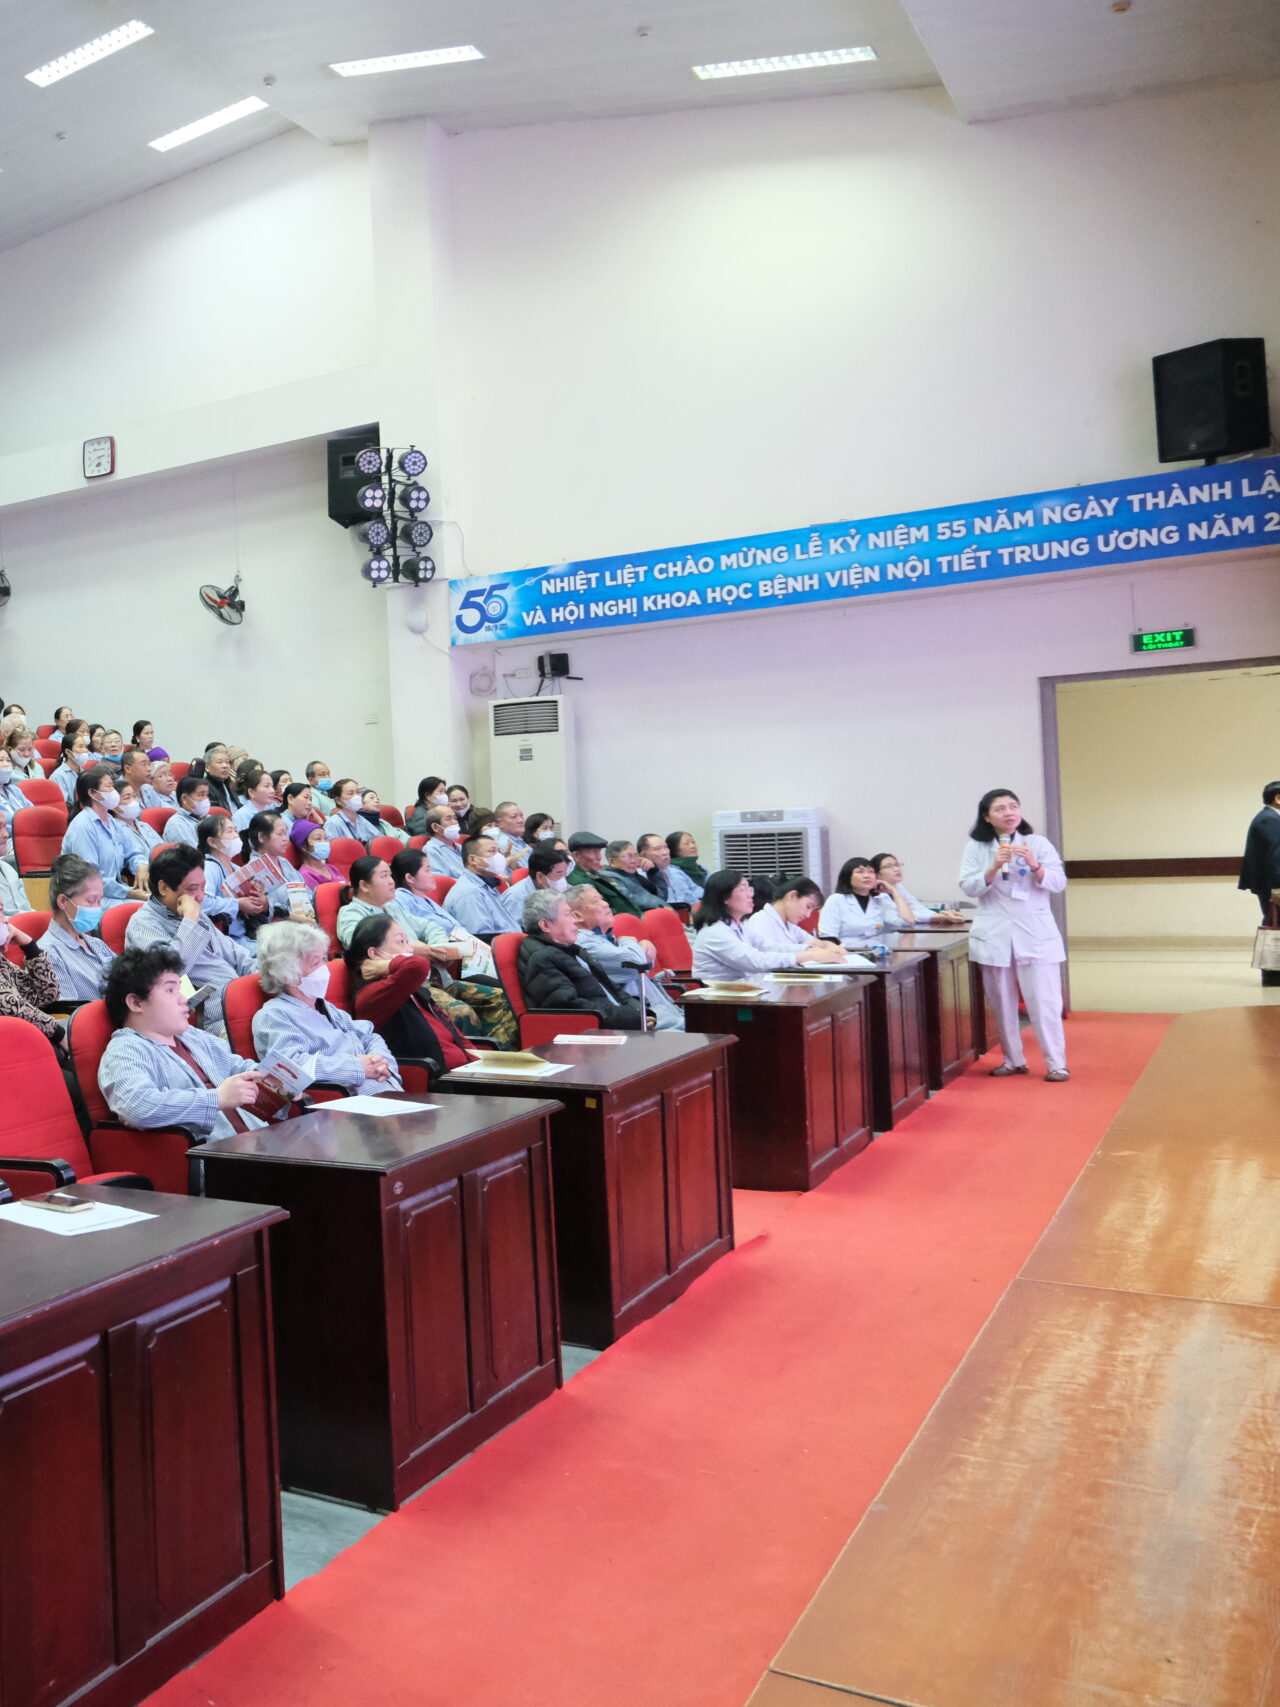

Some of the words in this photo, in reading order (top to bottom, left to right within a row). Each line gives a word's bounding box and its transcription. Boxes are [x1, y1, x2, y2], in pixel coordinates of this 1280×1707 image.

[522, 605, 547, 626] VÀ
[551, 601, 585, 624] HỘI
[589, 597, 638, 617] NGHỊ
[643, 589, 701, 612] KHOA
[706, 582, 752, 605] HỌC
[758, 574, 819, 599] BỆNH
[824, 563, 880, 589] VIỆN
[887, 555, 930, 581] NỘI
[936, 544, 992, 574] TIẾT
[997, 537, 1089, 566] TRUNG
[1097, 525, 1179, 553] ƯƠNG
[1188, 513, 1255, 541] NĂM
[541, 570, 599, 595] NHIỆT
[604, 564, 648, 587] LIỆT
[653, 555, 714, 580] CHÀO
[720, 547, 789, 571] MỪNG
[795, 532, 822, 560] LỄ
[829, 528, 862, 555] KỶ
[868, 523, 929, 550] NIỆM
[936, 520, 967, 540] 55
[974, 508, 1034, 535] NĂM
[1042, 495, 1119, 525] NGÀY
[1127, 481, 1232, 513] THÀNH
[455, 583, 510, 634] 55
[1142, 631, 1184, 644] EXIT
